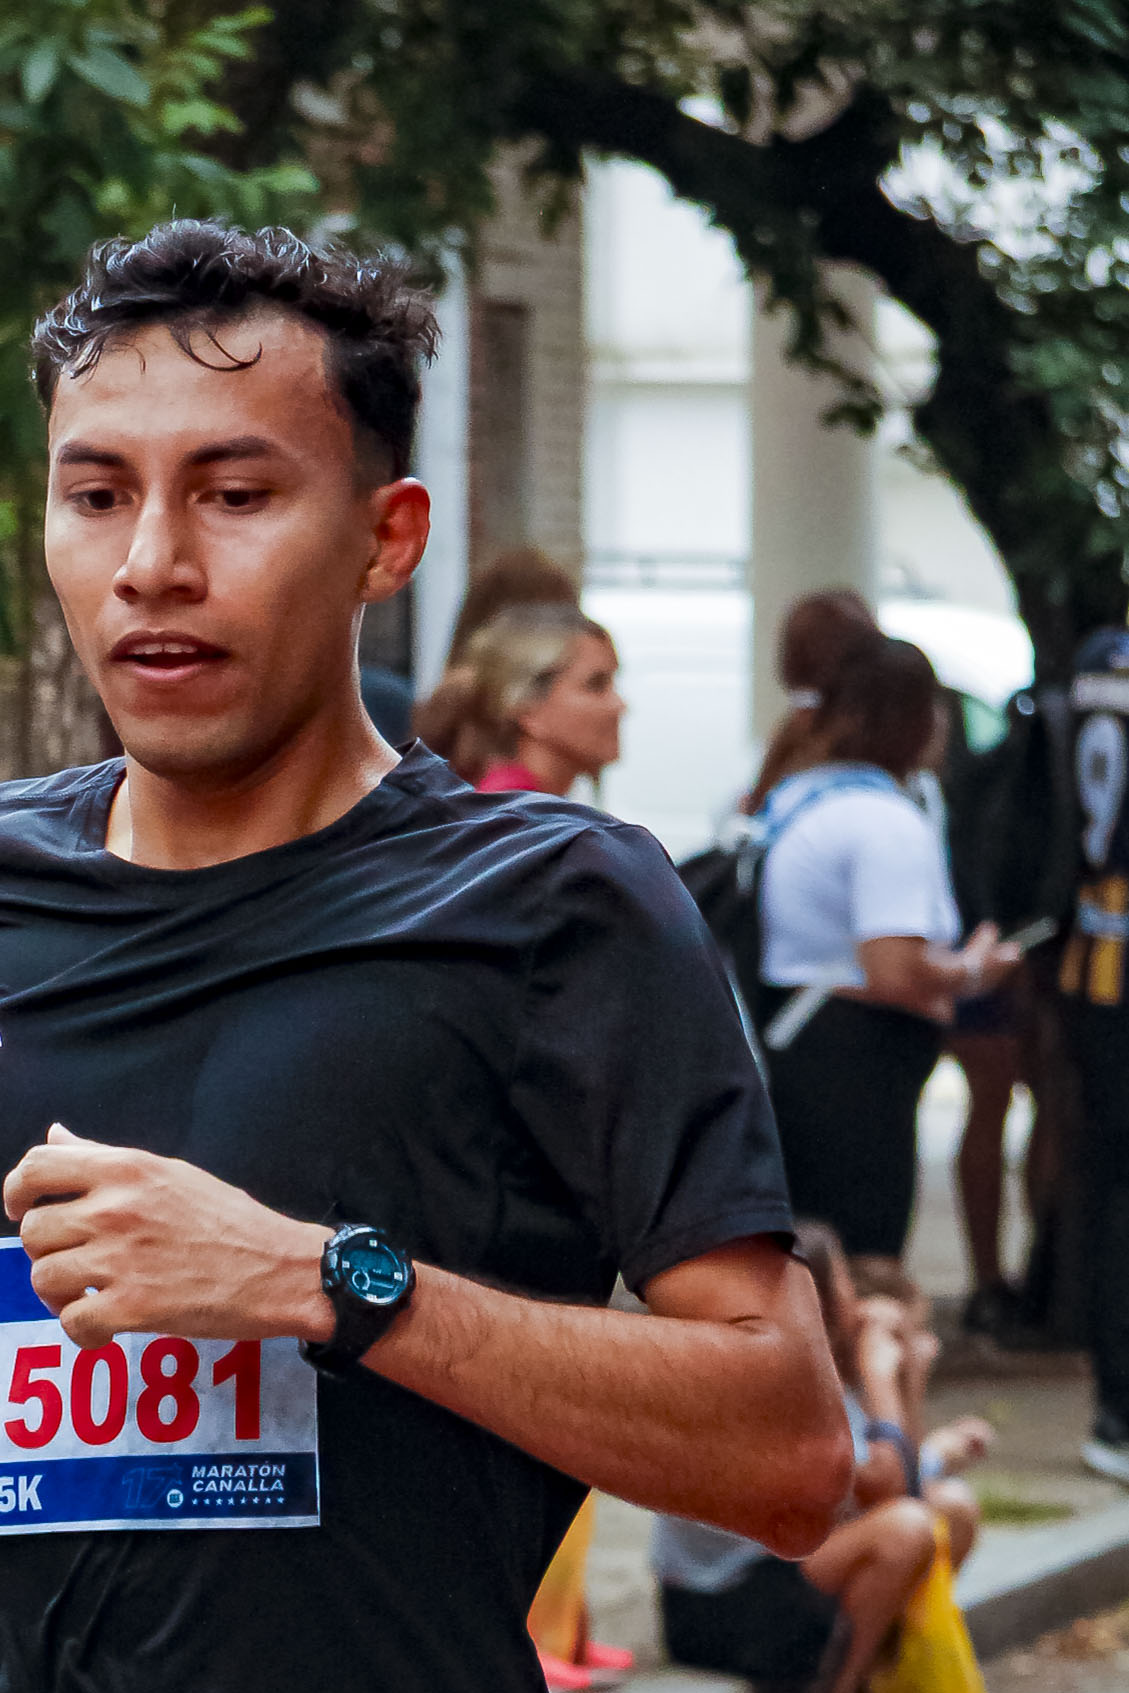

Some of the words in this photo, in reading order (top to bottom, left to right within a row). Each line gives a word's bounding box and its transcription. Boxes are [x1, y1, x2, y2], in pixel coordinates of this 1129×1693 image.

[4, 1337, 260, 1449] 5081
[191, 1460, 286, 1477] MARATÓN
[191, 1479, 286, 1492] CANALLA
